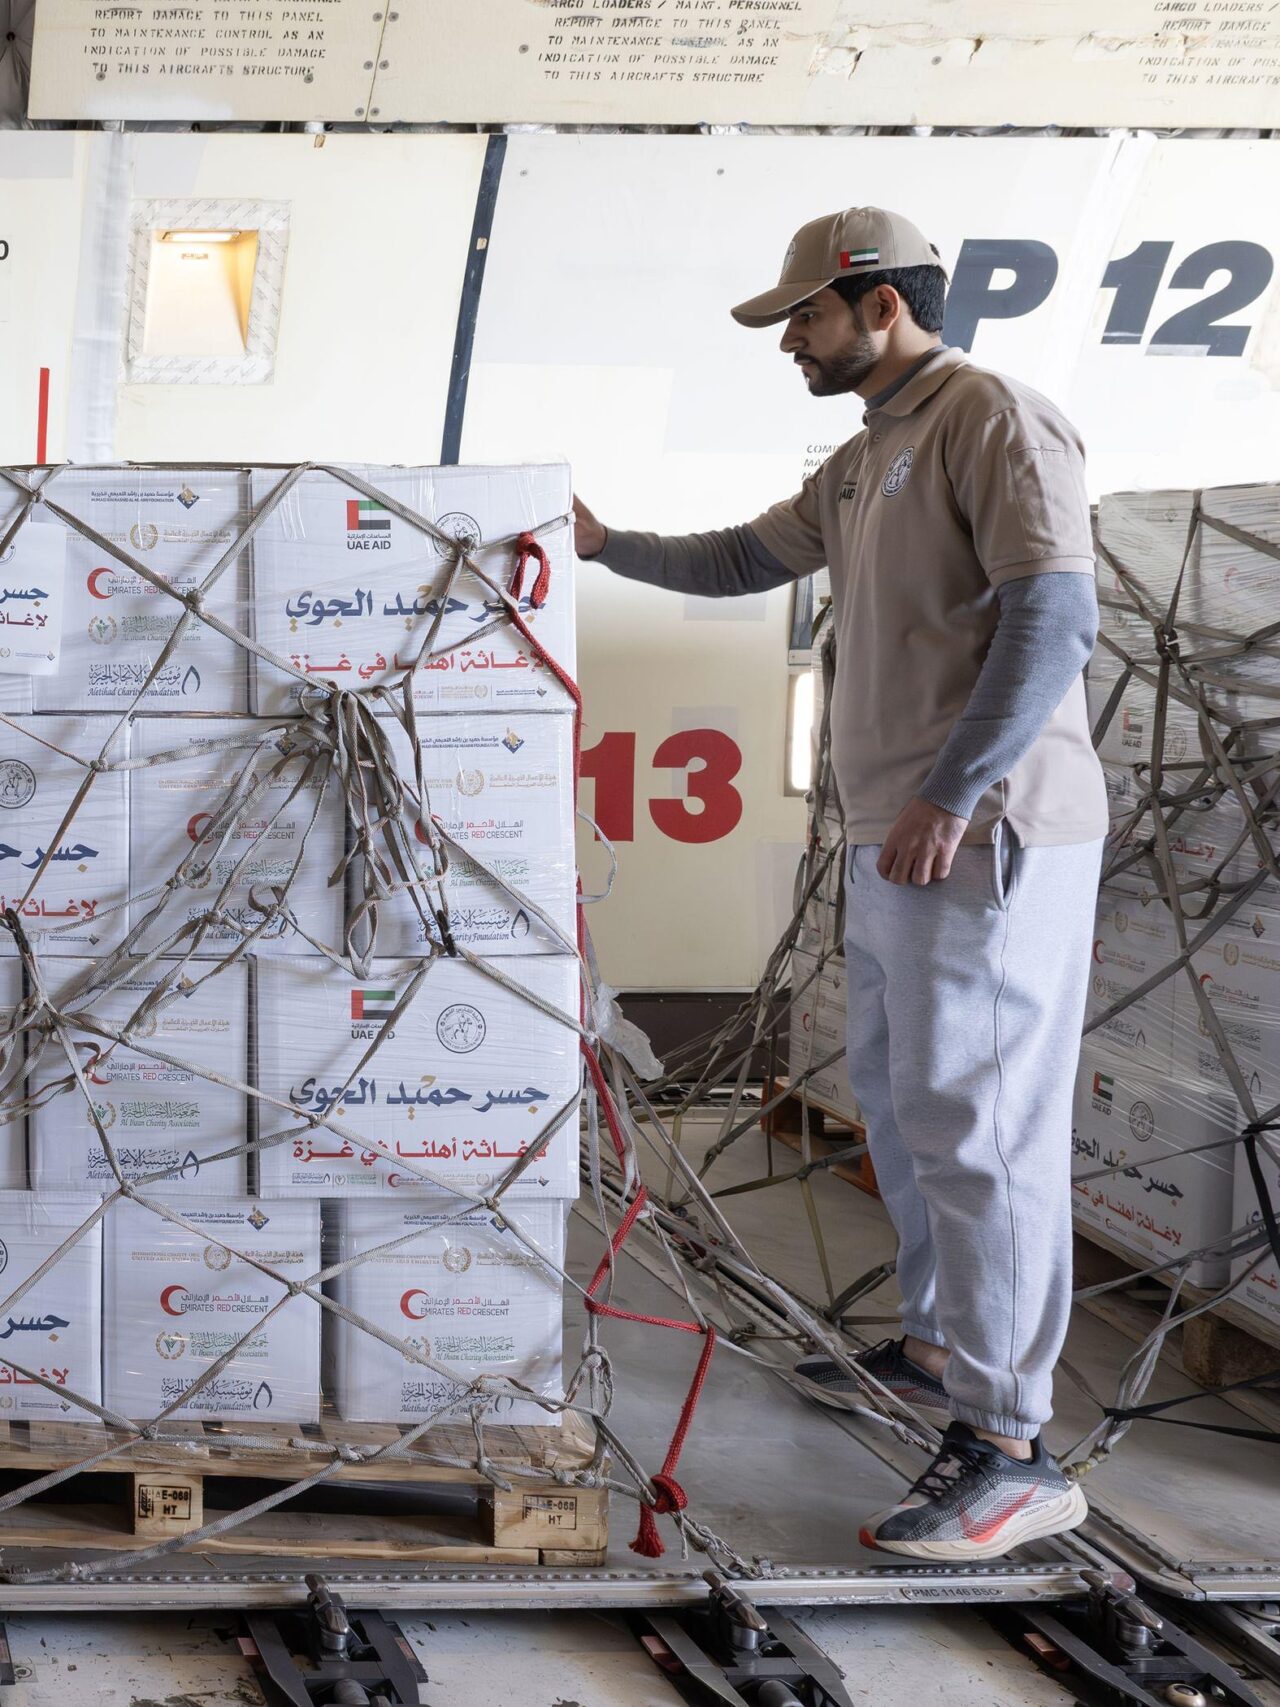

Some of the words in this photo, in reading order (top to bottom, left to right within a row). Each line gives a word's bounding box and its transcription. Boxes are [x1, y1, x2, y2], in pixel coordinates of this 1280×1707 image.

[592, 0, 651, 9] LOADERS
[729, 0, 802, 11] PERSONNEL
[1154, 2, 1197, 12] CARGO
[1203, 2, 1263, 12] LOADERS
[95, 10, 143, 20] REPORT
[152, 10, 203, 21] DAMAGE
[214, 11, 229, 21] TO
[240, 11, 273, 21] THIS
[282, 11, 323, 22] PANEL
[554, 18, 603, 28] REPORT
[612, 18, 663, 28] DAMAGE
[673, 19, 688, 28] TO
[699, 19, 732, 29] THIS
[1162, 20, 1211, 31] REPORT
[1219, 21, 1271, 31] DAMAGE
[91, 28, 106, 38] TO
[115, 28, 206, 38] MAINTENANCE
[215, 29, 273, 39] CONTROL
[283, 30, 299, 40] AS
[307, 30, 324, 40] AN
[548, 35, 563, 46] TO
[571, 36, 663, 46] MAINTENANCE
[738, 38, 754, 47] AS
[762, 38, 779, 48] AN
[84, 45, 166, 56] INDICATION
[175, 46, 190, 57] OF
[200, 47, 268, 57] POSSIBLE
[278, 48, 326, 59] DAMAGE
[538, 53, 621, 63] INDICATION
[629, 54, 644, 64] OF
[654, 54, 721, 65] POSSIBLE
[730, 55, 779, 66] DAMAGE
[92, 62, 108, 73] TO
[118, 63, 150, 74] THIS
[159, 64, 234, 75] AIRCRAFTS
[242, 65, 315, 76] STRUCTURE
[544, 71, 560, 81] TO
[569, 71, 602, 81] THIS
[610, 72, 684, 82] AIRCRAFTS
[692, 73, 765, 83] STRUCTURE
[1099, 240, 1275, 357] 12
[347, 540, 370, 551] UAE
[372, 540, 391, 551] AID
[285, 587, 372, 633] الجوي
[359, 653, 387, 680] في
[579, 728, 743, 844] 13
[472, 830, 486, 839] RED
[487, 830, 524, 839] CRESCENT
[21, 842, 100, 874] جسر
[351, 1030, 374, 1040] UAE
[107, 1072, 141, 1081] EMIRATES
[143, 1072, 157, 1081] RED
[157, 1073, 194, 1082] CRESCENT
[472, 1085, 550, 1115] جسر
[146, 1118, 167, 1129] Charity
[293, 1139, 354, 1162] غزة
[396, 1136, 457, 1160] أهلنا
[1143, 1173, 1184, 1207] جسر
[181, 1304, 214, 1313] EMIRATES
[217, 1304, 231, 1312] RED
[232, 1305, 268, 1314] CRESCENT
[421, 1307, 455, 1316] EMIRATES
[457, 1307, 471, 1315] RED
[472, 1308, 509, 1316] CRESCENT
[163, 1504, 178, 1515] HT
[548, 1514, 562, 1526] HT
[911, 1588, 940, 1598] PMC
[942, 1588, 970, 1597] 1146
[972, 1588, 997, 1597] BSC
